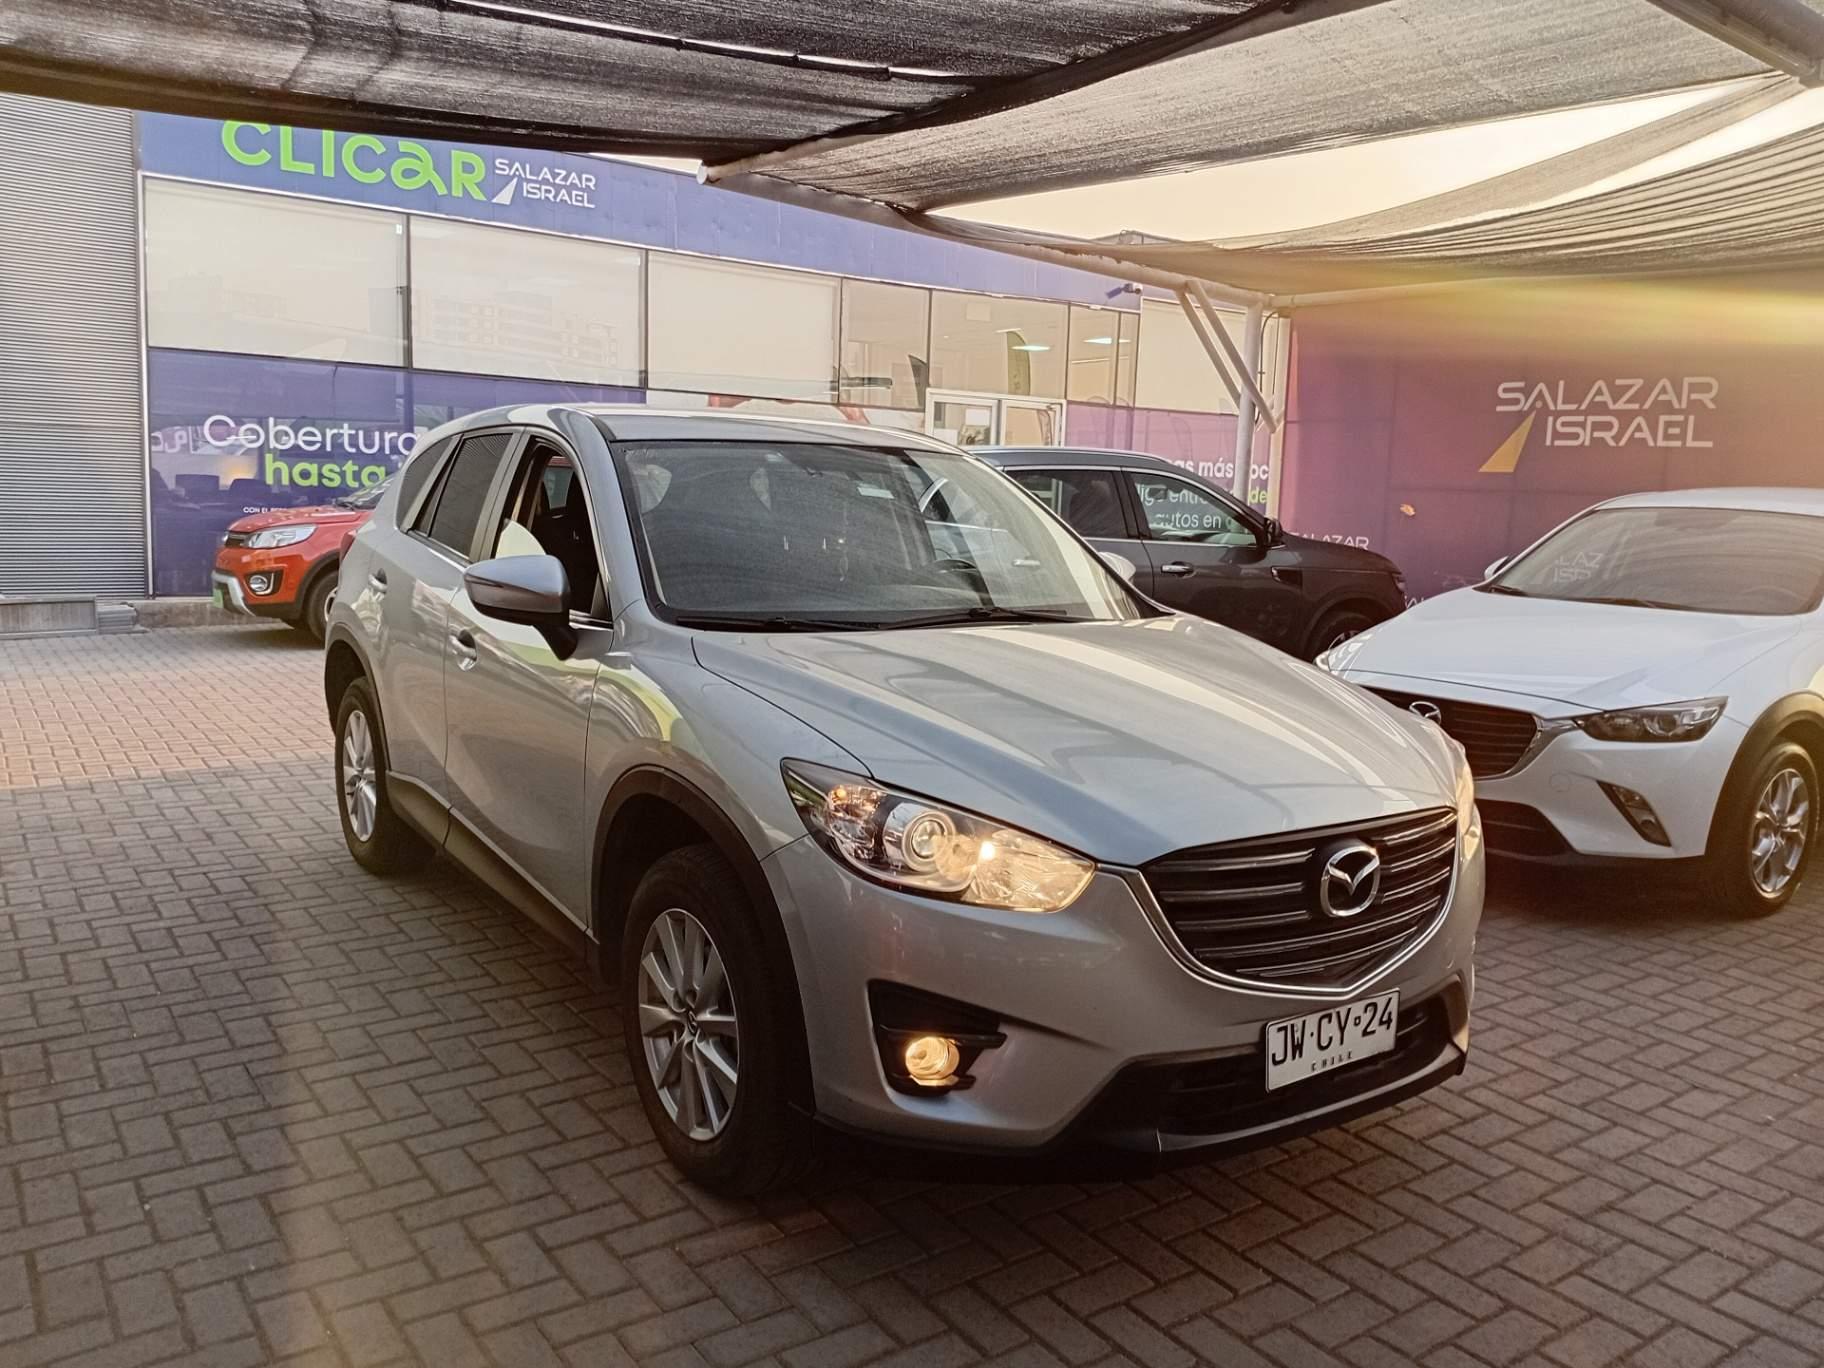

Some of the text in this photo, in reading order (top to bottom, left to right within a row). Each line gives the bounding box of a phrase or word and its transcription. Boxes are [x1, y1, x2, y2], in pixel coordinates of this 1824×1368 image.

[495, 159, 596, 190] SALAZAR
[523, 182, 596, 208] ISRAEL
[1496, 376, 1719, 412] SALAZAR
[1546, 414, 1714, 448] ISRAEL
[265, 453, 387, 488] hasta
[1198, 457, 1234, 478] más
[1203, 514, 1222, 529] en
[1311, 1050, 1353, 1073] CHILE
